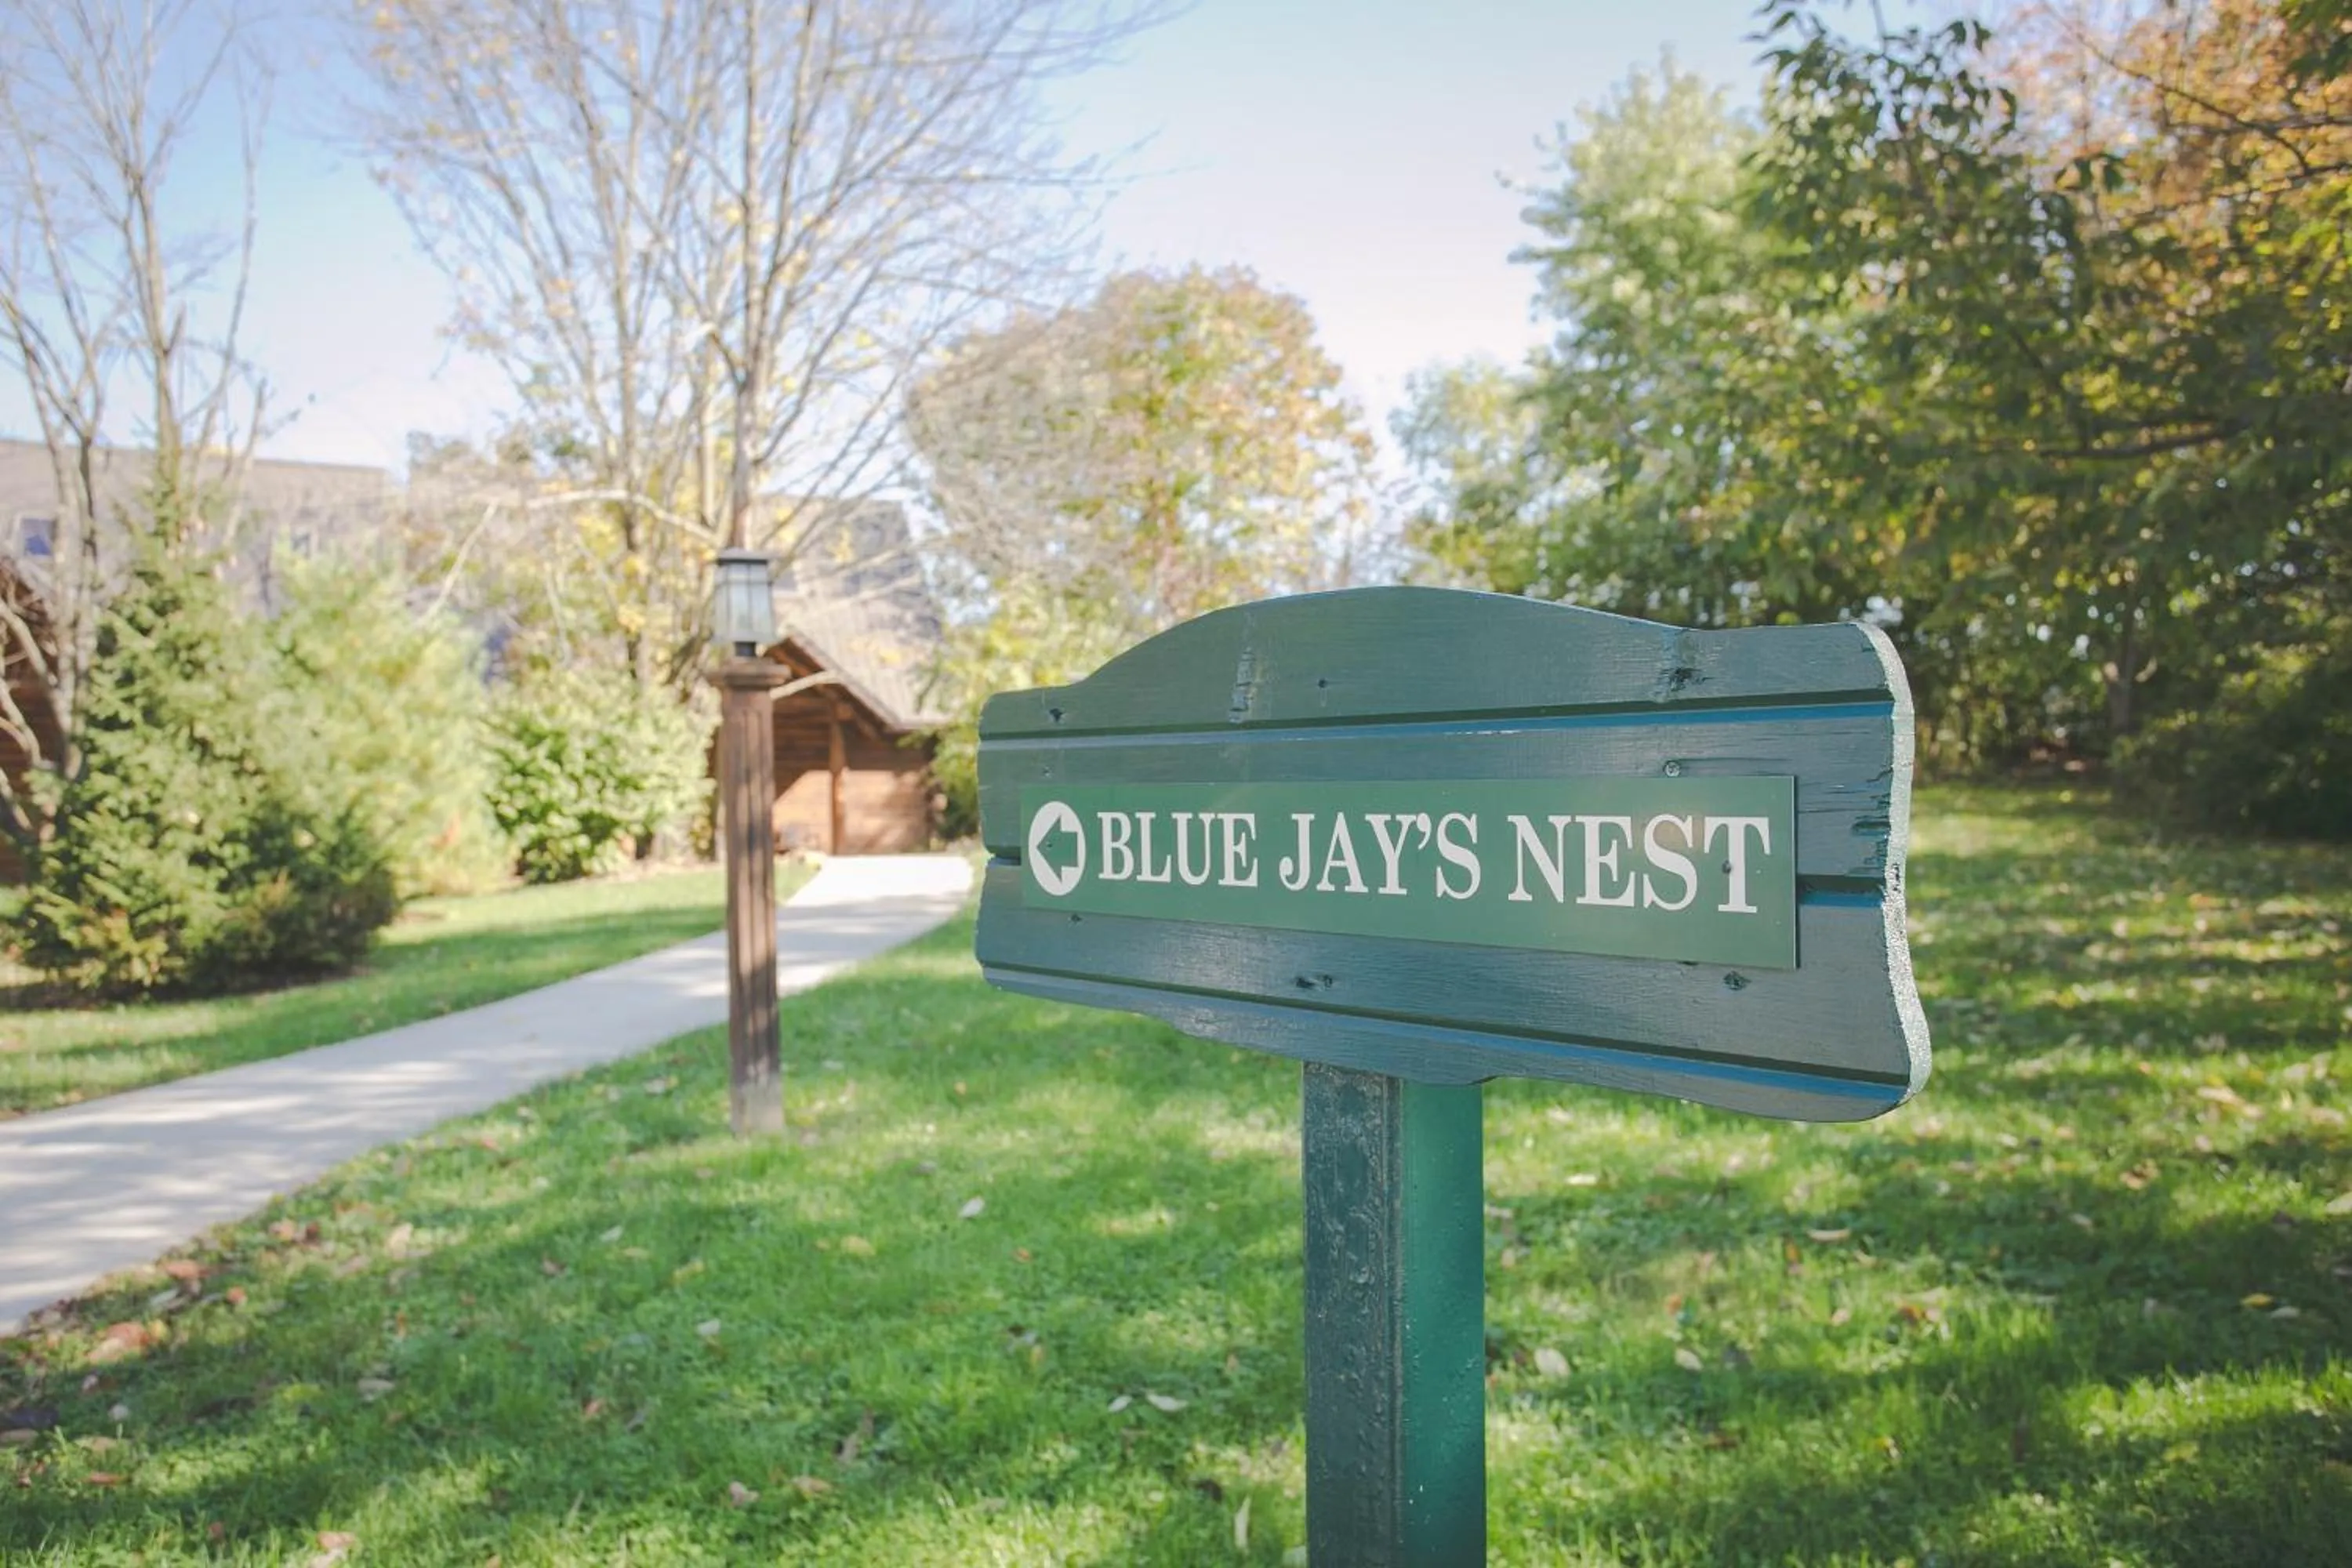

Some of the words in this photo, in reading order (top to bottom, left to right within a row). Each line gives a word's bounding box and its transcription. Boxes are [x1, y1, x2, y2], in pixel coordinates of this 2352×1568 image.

[1097, 811, 1259, 887] BLUE
[1279, 812, 1482, 900] JAY’S
[1507, 814, 1771, 914] NEST
